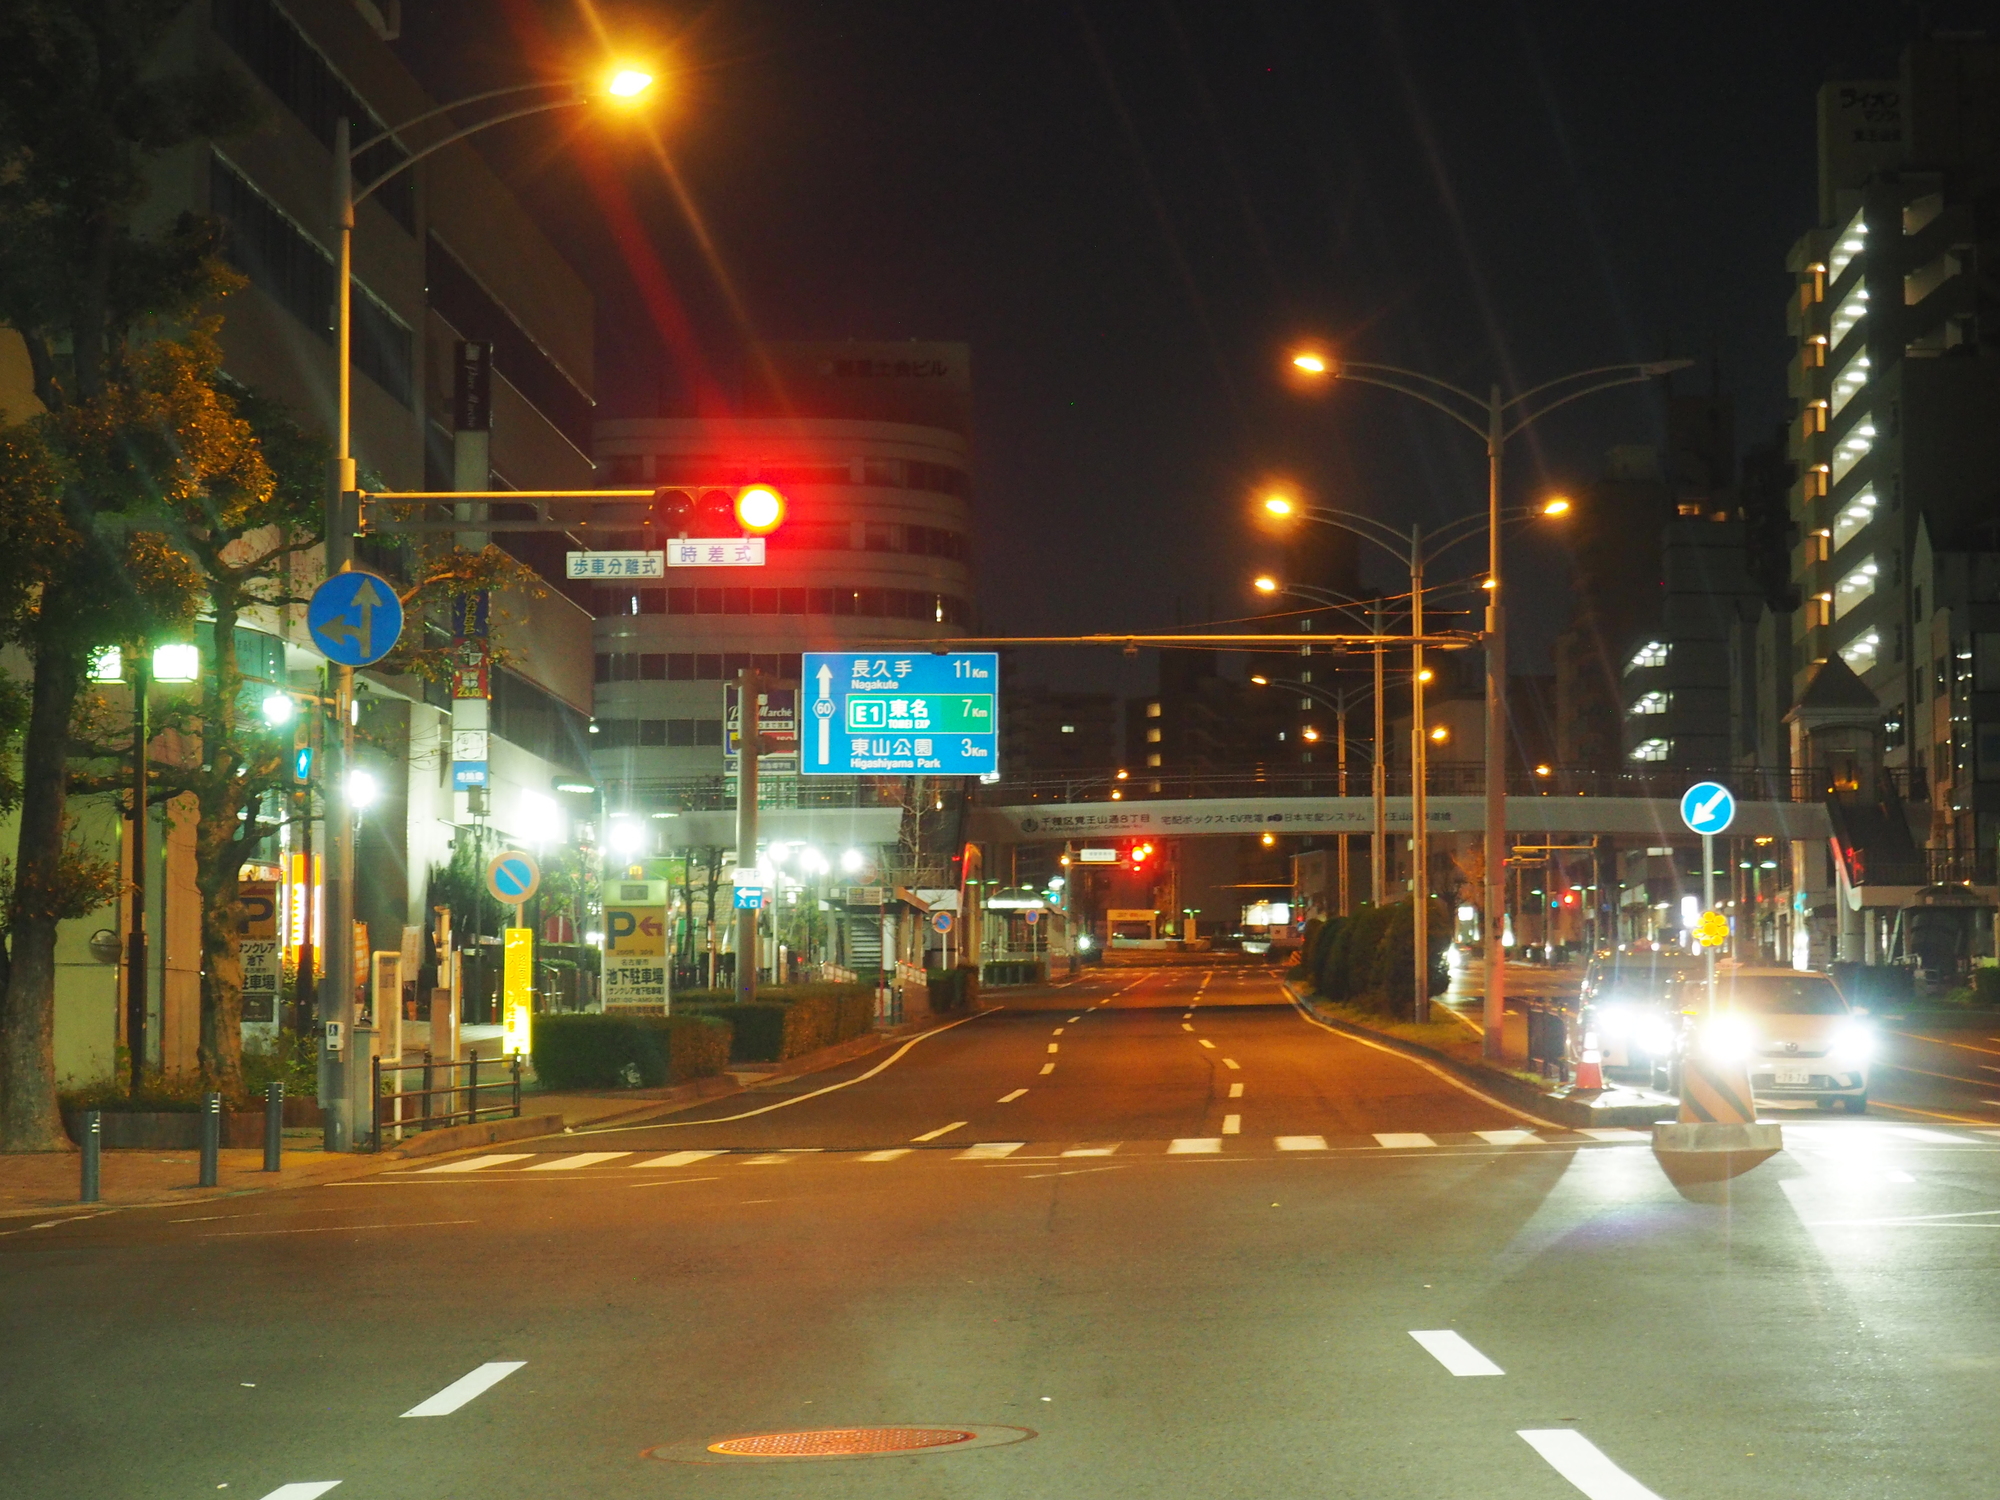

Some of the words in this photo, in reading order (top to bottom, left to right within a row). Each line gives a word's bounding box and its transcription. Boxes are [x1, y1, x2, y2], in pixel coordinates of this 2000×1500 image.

[681, 545, 751, 563] 時差式
[573, 558, 657, 576] 歩車分離式
[851, 659, 913, 679] 長久手
[851, 680, 899, 692] Nagakute
[758, 705, 793, 718] Marché
[816, 702, 830, 715] 60
[888, 698, 929, 719] 東名
[914, 719, 931, 730] EXP
[851, 738, 933, 757] 東山公園
[851, 758, 914, 771] Higashiyama
[917, 758, 941, 769] Park
[738, 899, 759, 908] 入口
[607, 911, 637, 950] P
[246, 955, 265, 967] 池下
[606, 967, 664, 985] 池下駐車場
